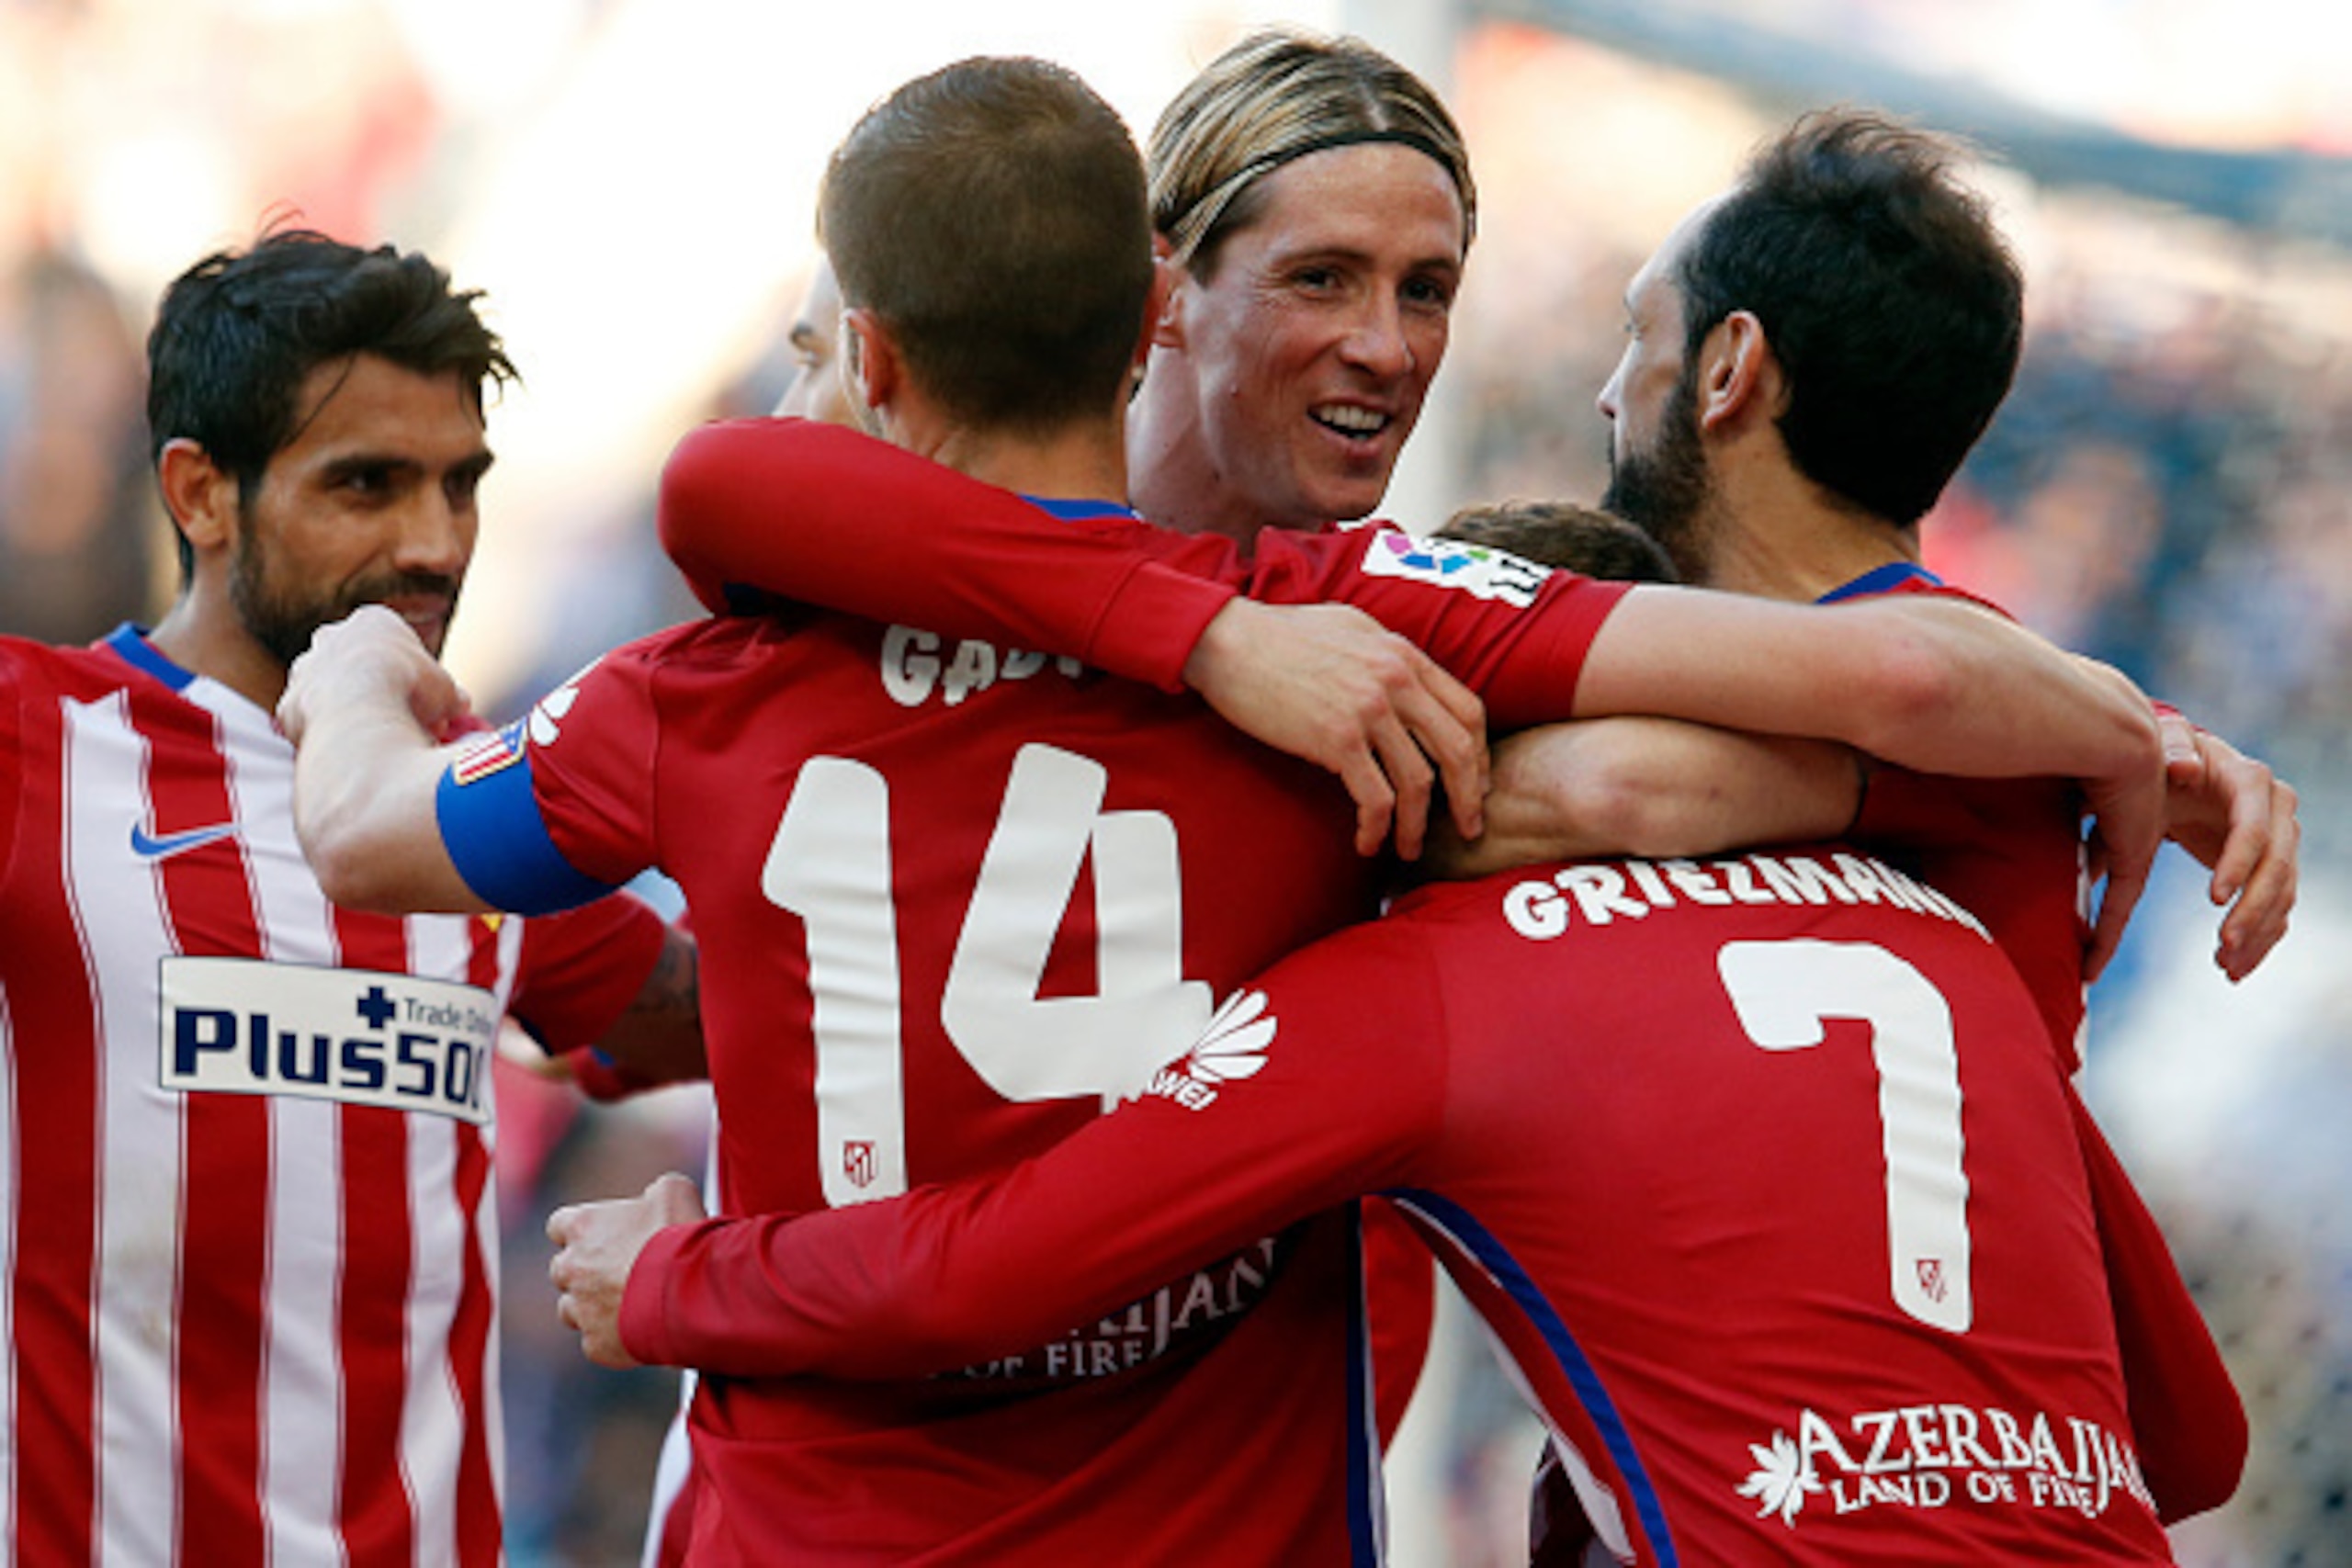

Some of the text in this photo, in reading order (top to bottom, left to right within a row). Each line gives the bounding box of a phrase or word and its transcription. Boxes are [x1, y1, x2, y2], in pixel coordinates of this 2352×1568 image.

[762, 742, 1215, 1208] 14
[1716, 939, 1973, 1335] 7
[1830, 1472, 1951, 1515] LAND
[1966, 1471, 2017, 1503] OF
